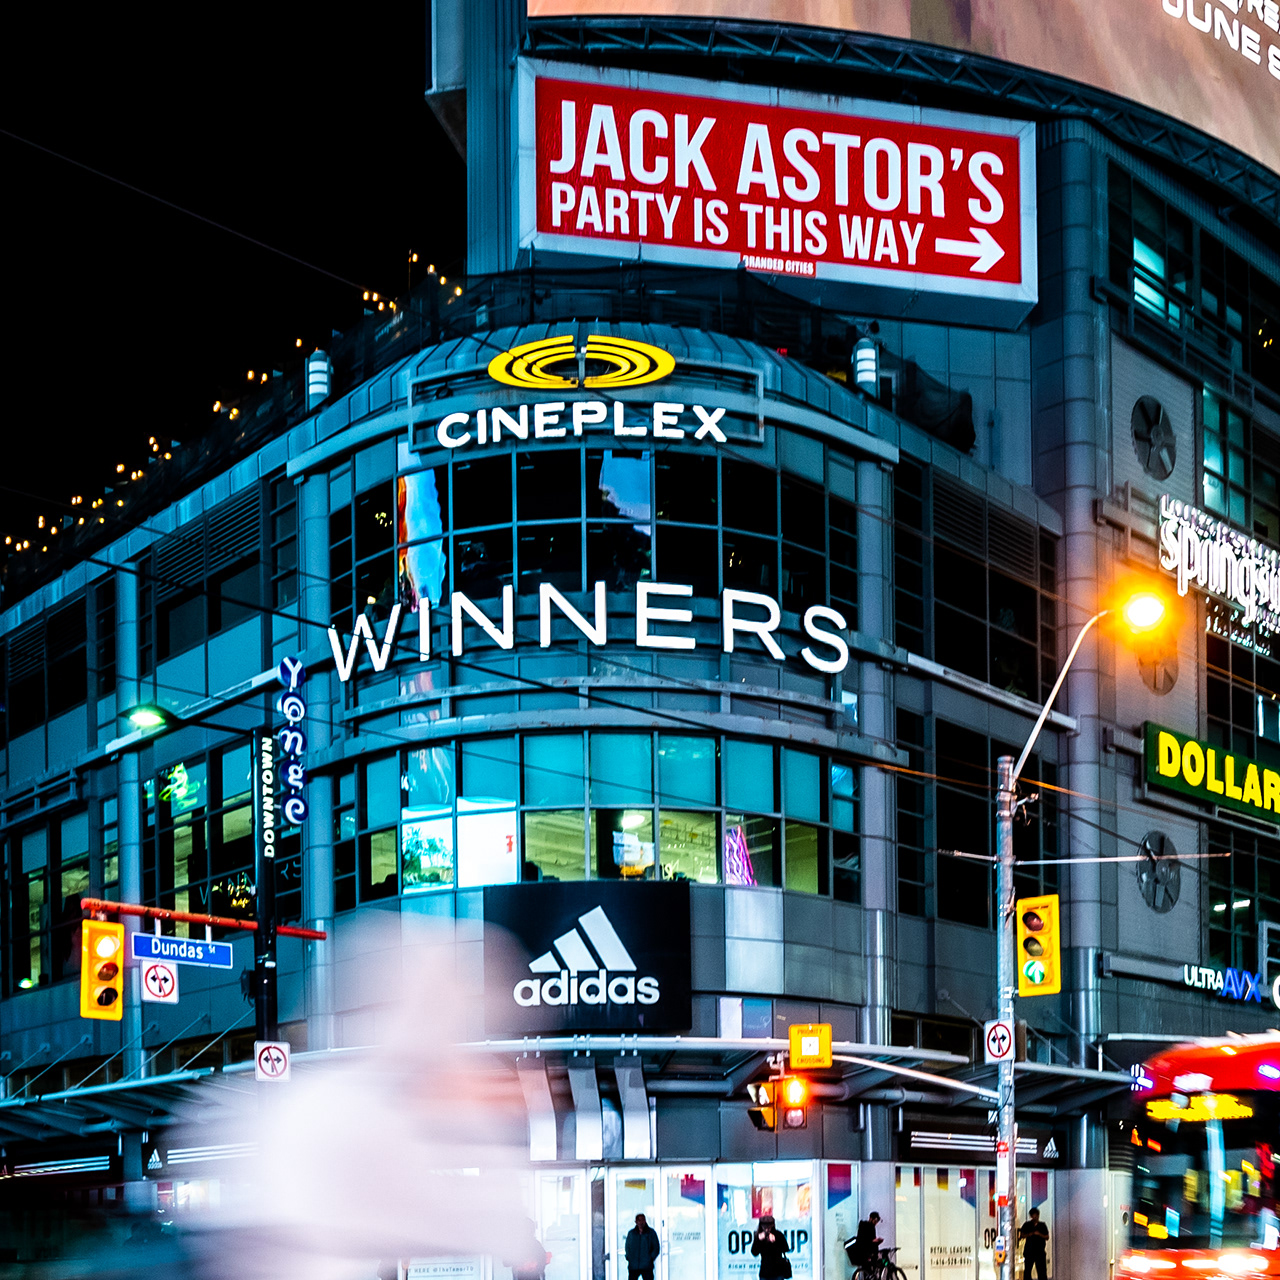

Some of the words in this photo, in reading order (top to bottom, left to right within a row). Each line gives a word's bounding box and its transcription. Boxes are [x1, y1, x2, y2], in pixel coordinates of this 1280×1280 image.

[550, 100, 717, 191] JACK
[737, 122, 1004, 225] ASTOR'S
[552, 182, 681, 239] PARTY
[694, 197, 729, 244] IS
[740, 203, 827, 255] THIS
[839, 214, 924, 265] WAY
[744, 255, 784, 273] BRANDED
[785, 260, 814, 276] CITIES
[437, 401, 728, 448] CINEPLEX
[328, 581, 849, 682] WINNERS
[281, 657, 307, 824] Yonge
[261, 737, 275, 858] DOWNTOWN
[152, 938, 203, 959] Dundas
[208, 945, 215, 954] St
[513, 968, 660, 1007] adidas
[728, 1230, 756, 1254] OP
